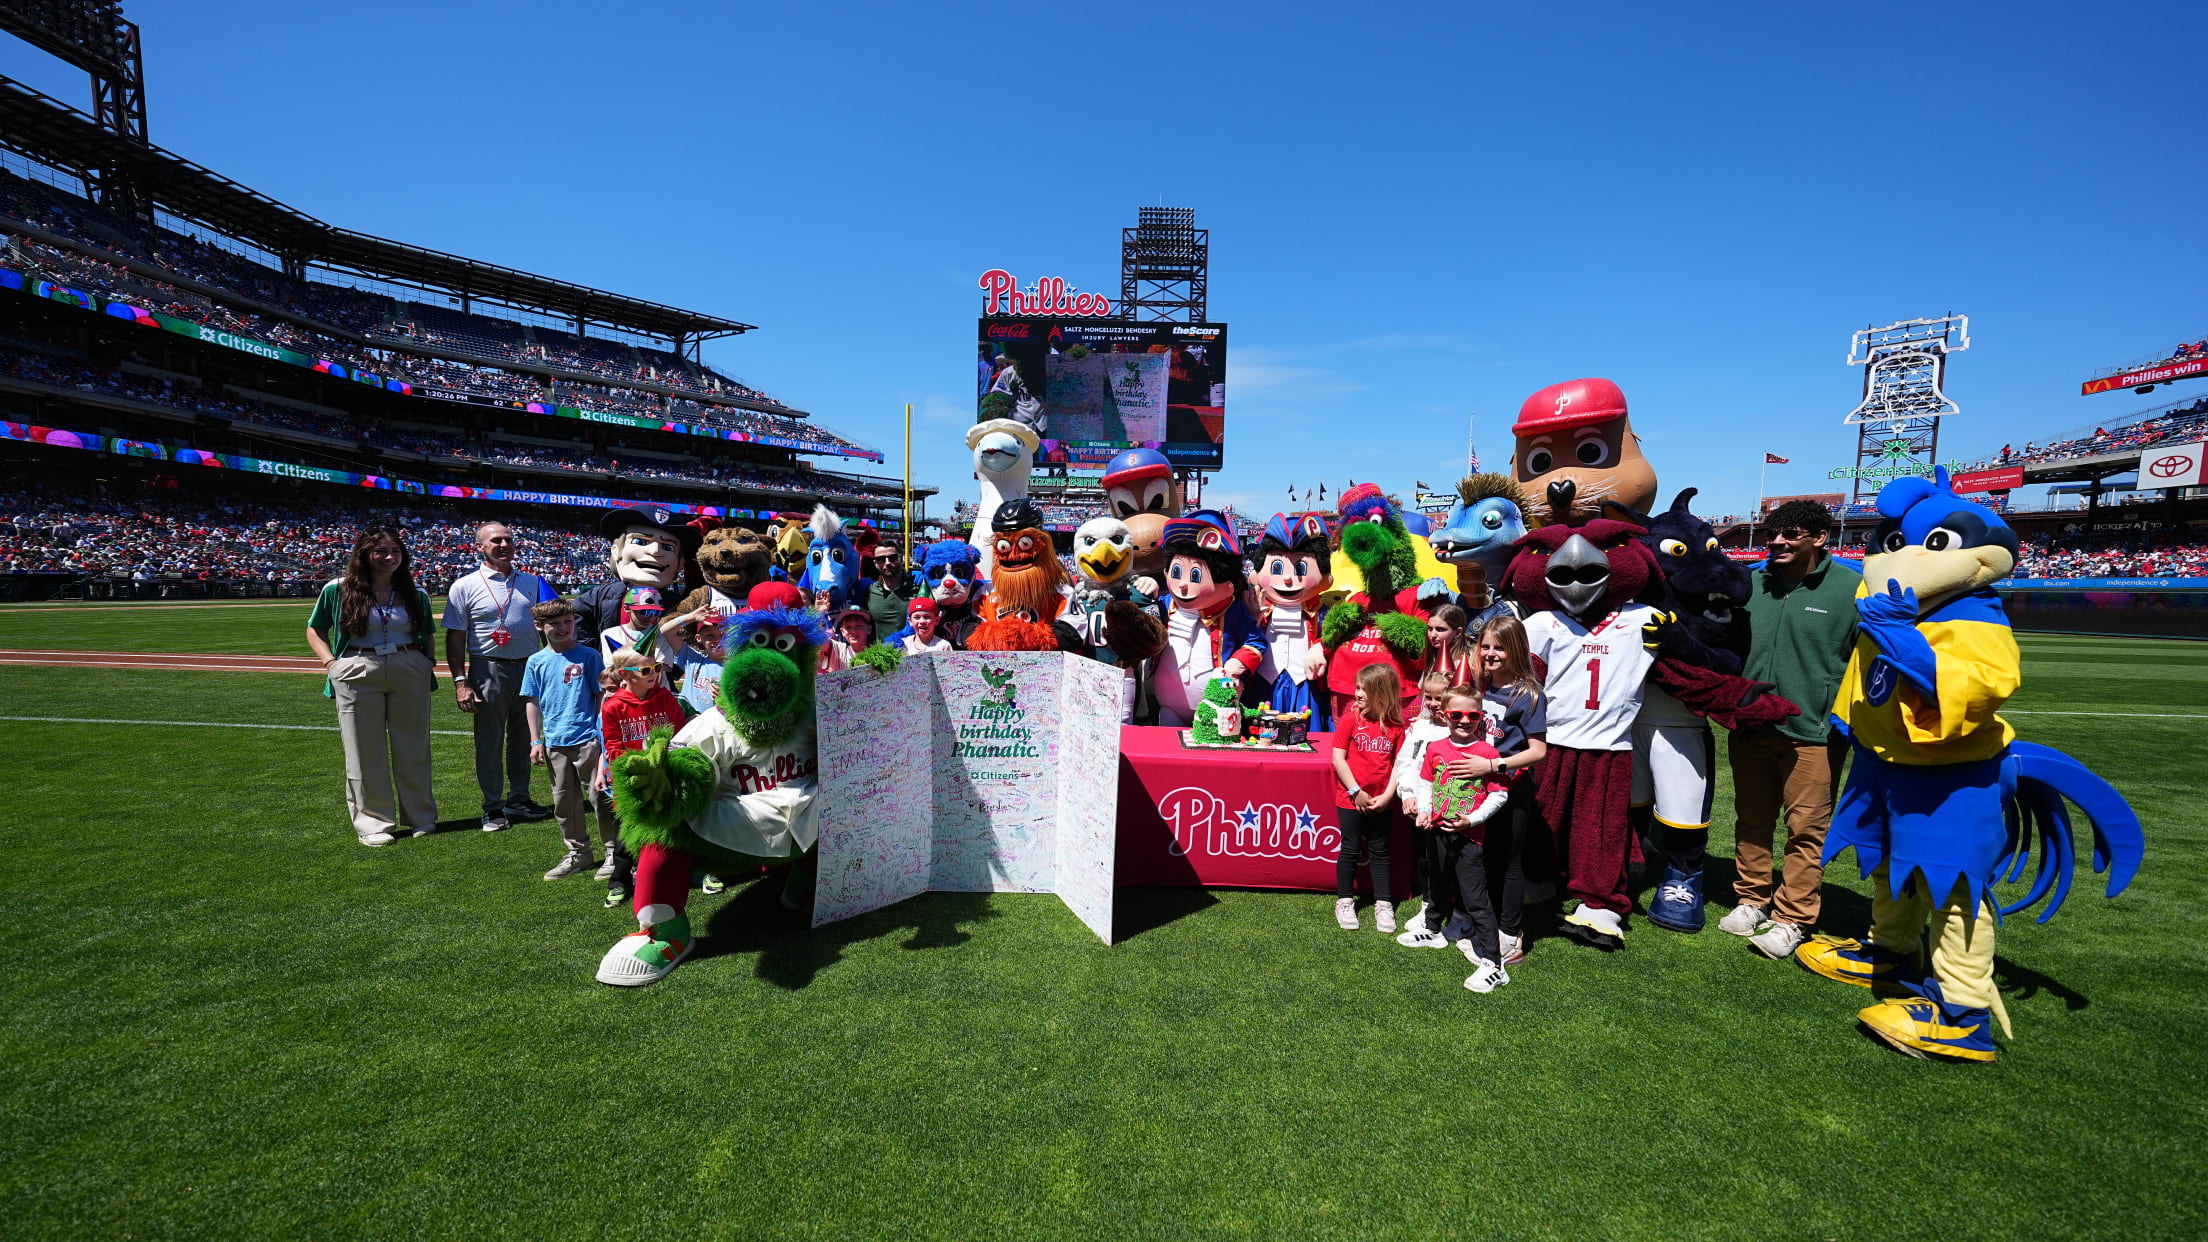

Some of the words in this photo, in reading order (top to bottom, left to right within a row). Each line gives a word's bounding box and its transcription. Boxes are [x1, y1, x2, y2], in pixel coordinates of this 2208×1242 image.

[979, 268, 1110, 316] Phillies
[1172, 326, 1220, 335] theScore
[217, 332, 280, 360] Citizens
[2121, 369, 2172, 386] Phillies
[2174, 362, 2202, 375] win
[425, 390, 455, 400] 1:20:26
[1554, 393, 1571, 415] P
[592, 412, 636, 426] Citizens
[769, 438, 798, 448] HAPPY
[799, 441, 839, 454] BIRTHDAY
[274, 463, 331, 481] Citizens
[1832, 465, 1907, 479] Citizens
[1029, 475, 1067, 486] tizens
[1068, 475, 1100, 487] Bank
[503, 491, 547, 503] HAPPY
[550, 494, 608, 507] BIRTHDAY
[1582, 644, 1609, 655] TEMPLE
[563, 663, 583, 684] P
[1585, 658, 1600, 710] 1
[970, 705, 1026, 724] Happy
[960, 724, 1032, 743] birthday,
[950, 741, 1039, 758] Phanatic.
[980, 771, 1019, 780] Citizens
[1158, 786, 1342, 863] Phillie
